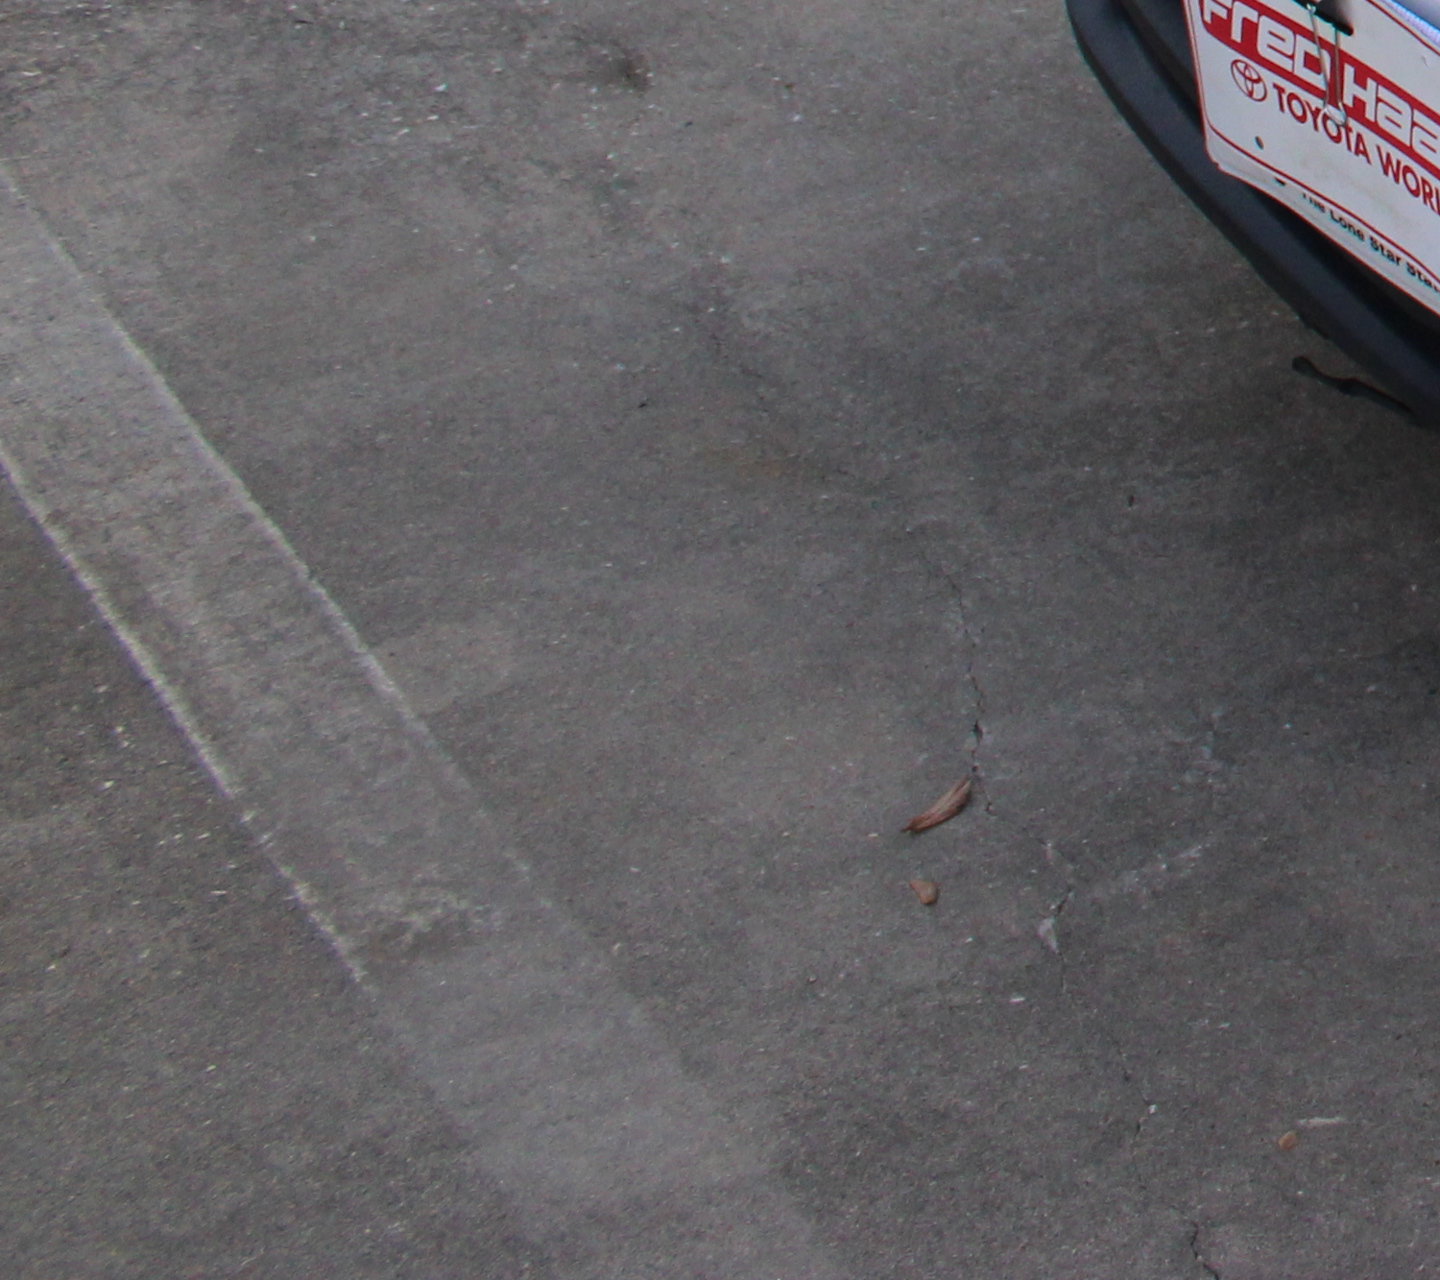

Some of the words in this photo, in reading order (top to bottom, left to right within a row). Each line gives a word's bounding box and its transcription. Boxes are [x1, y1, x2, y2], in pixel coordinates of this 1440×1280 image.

[1272, 82, 1373, 166] TOYOTA
[1329, 208, 1365, 242] Lone
[1369, 235, 1402, 267] Star
